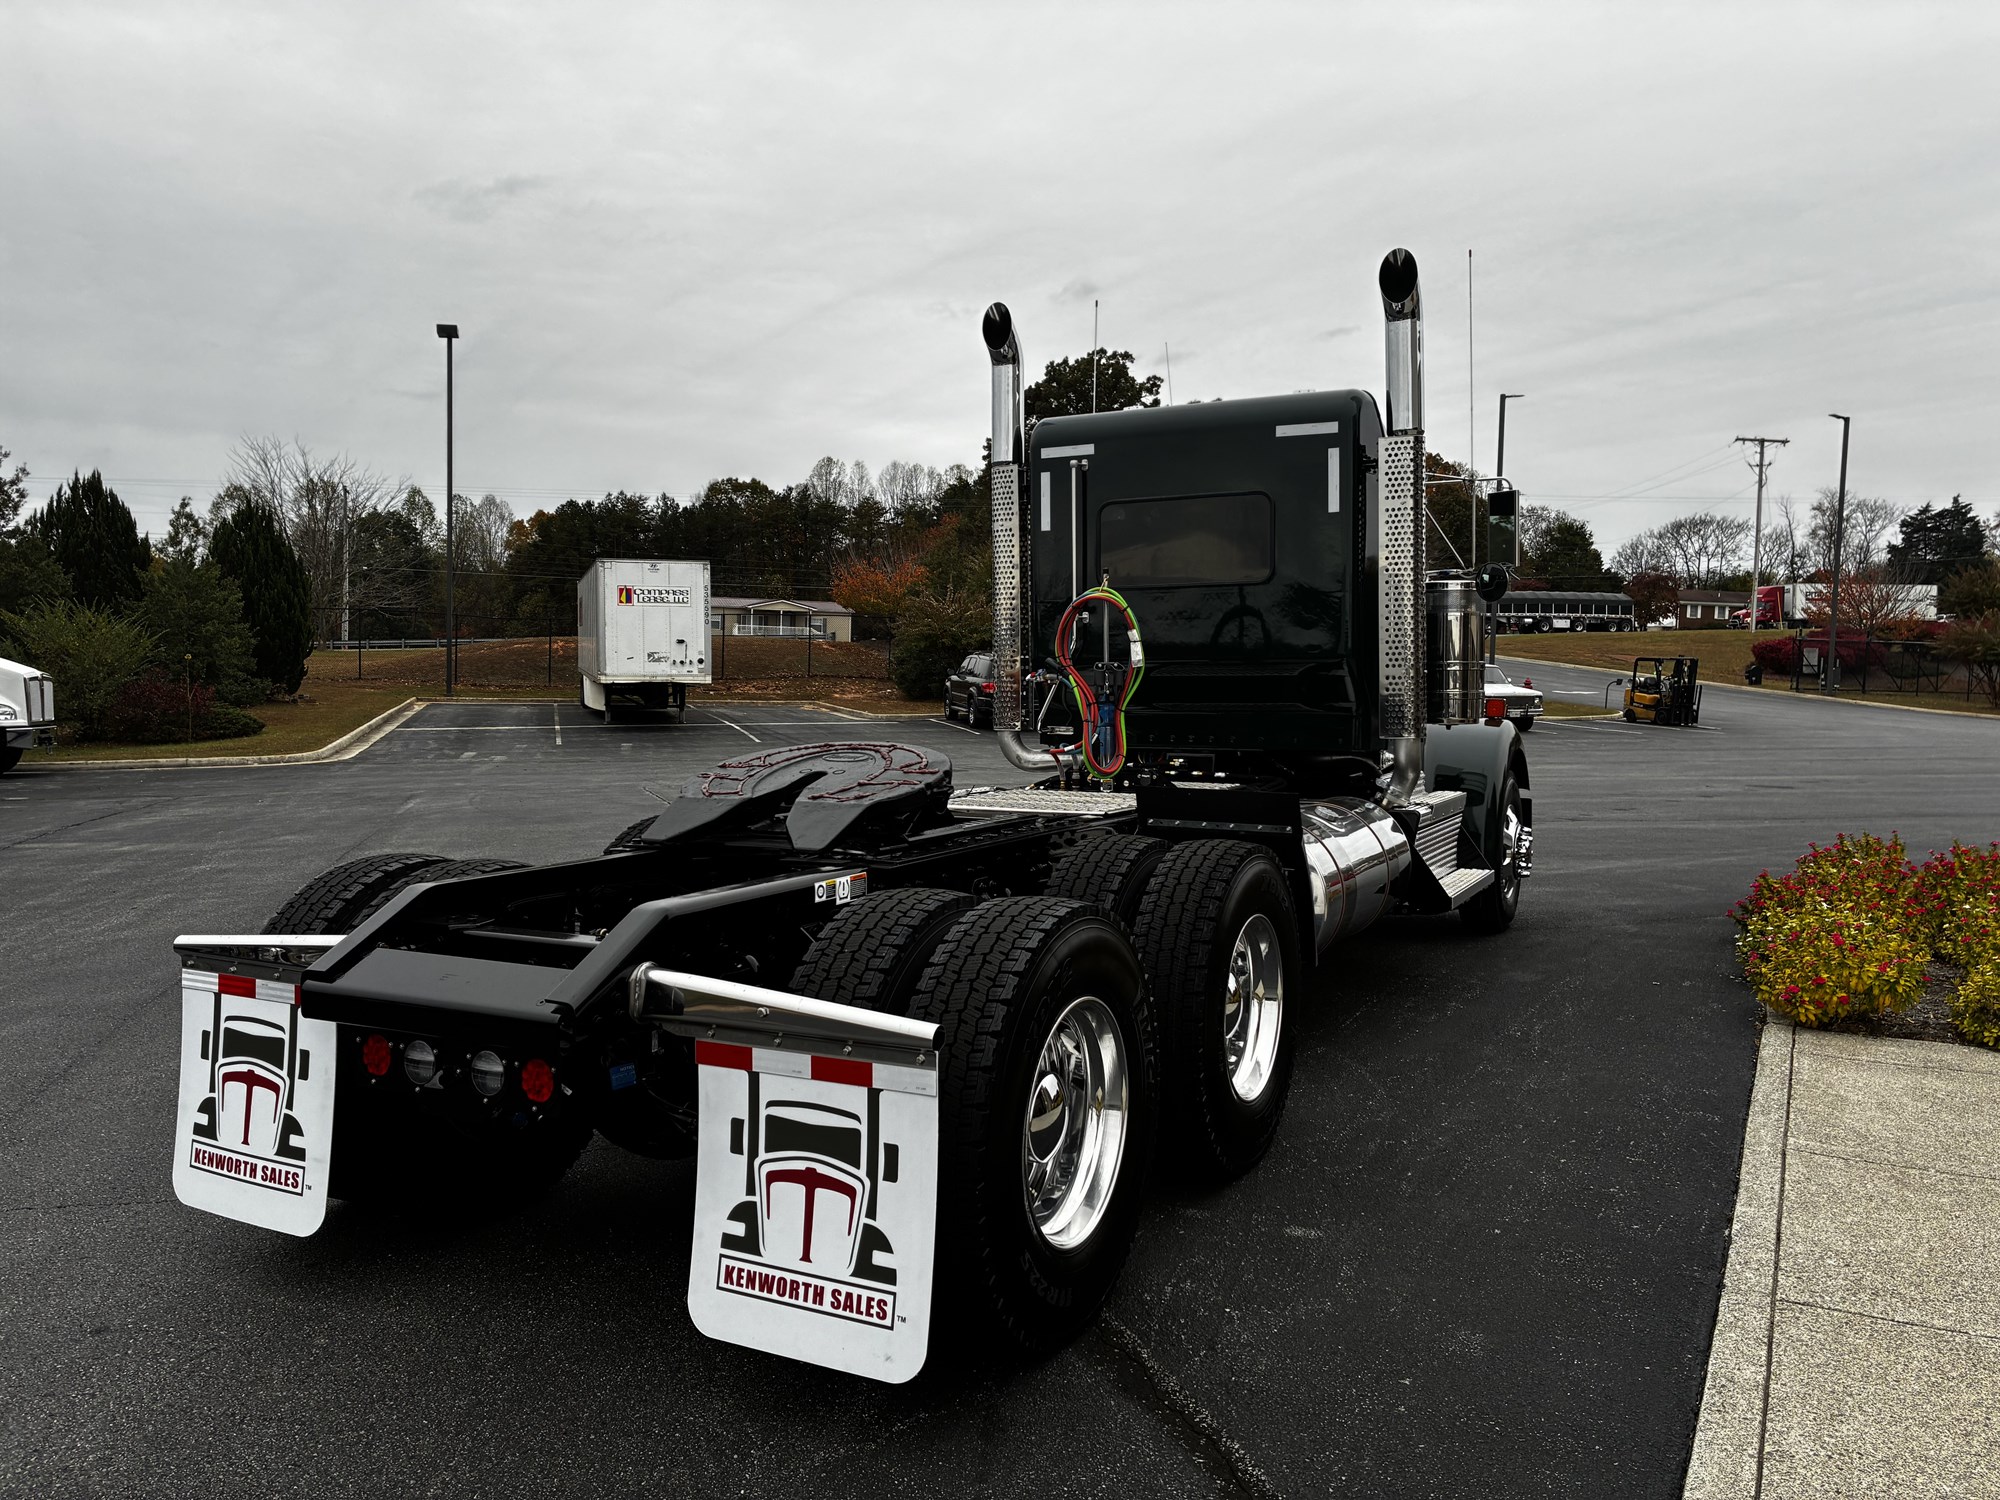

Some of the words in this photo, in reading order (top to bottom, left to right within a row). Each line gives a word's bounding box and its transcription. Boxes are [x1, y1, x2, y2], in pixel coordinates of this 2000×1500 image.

[194, 1147, 258, 1180] KENWORTH
[261, 1165, 300, 1189] SALES
[723, 1264, 825, 1306] KENWORTH
[830, 1288, 889, 1321] SALES
[897, 1315, 907, 1324] TM
